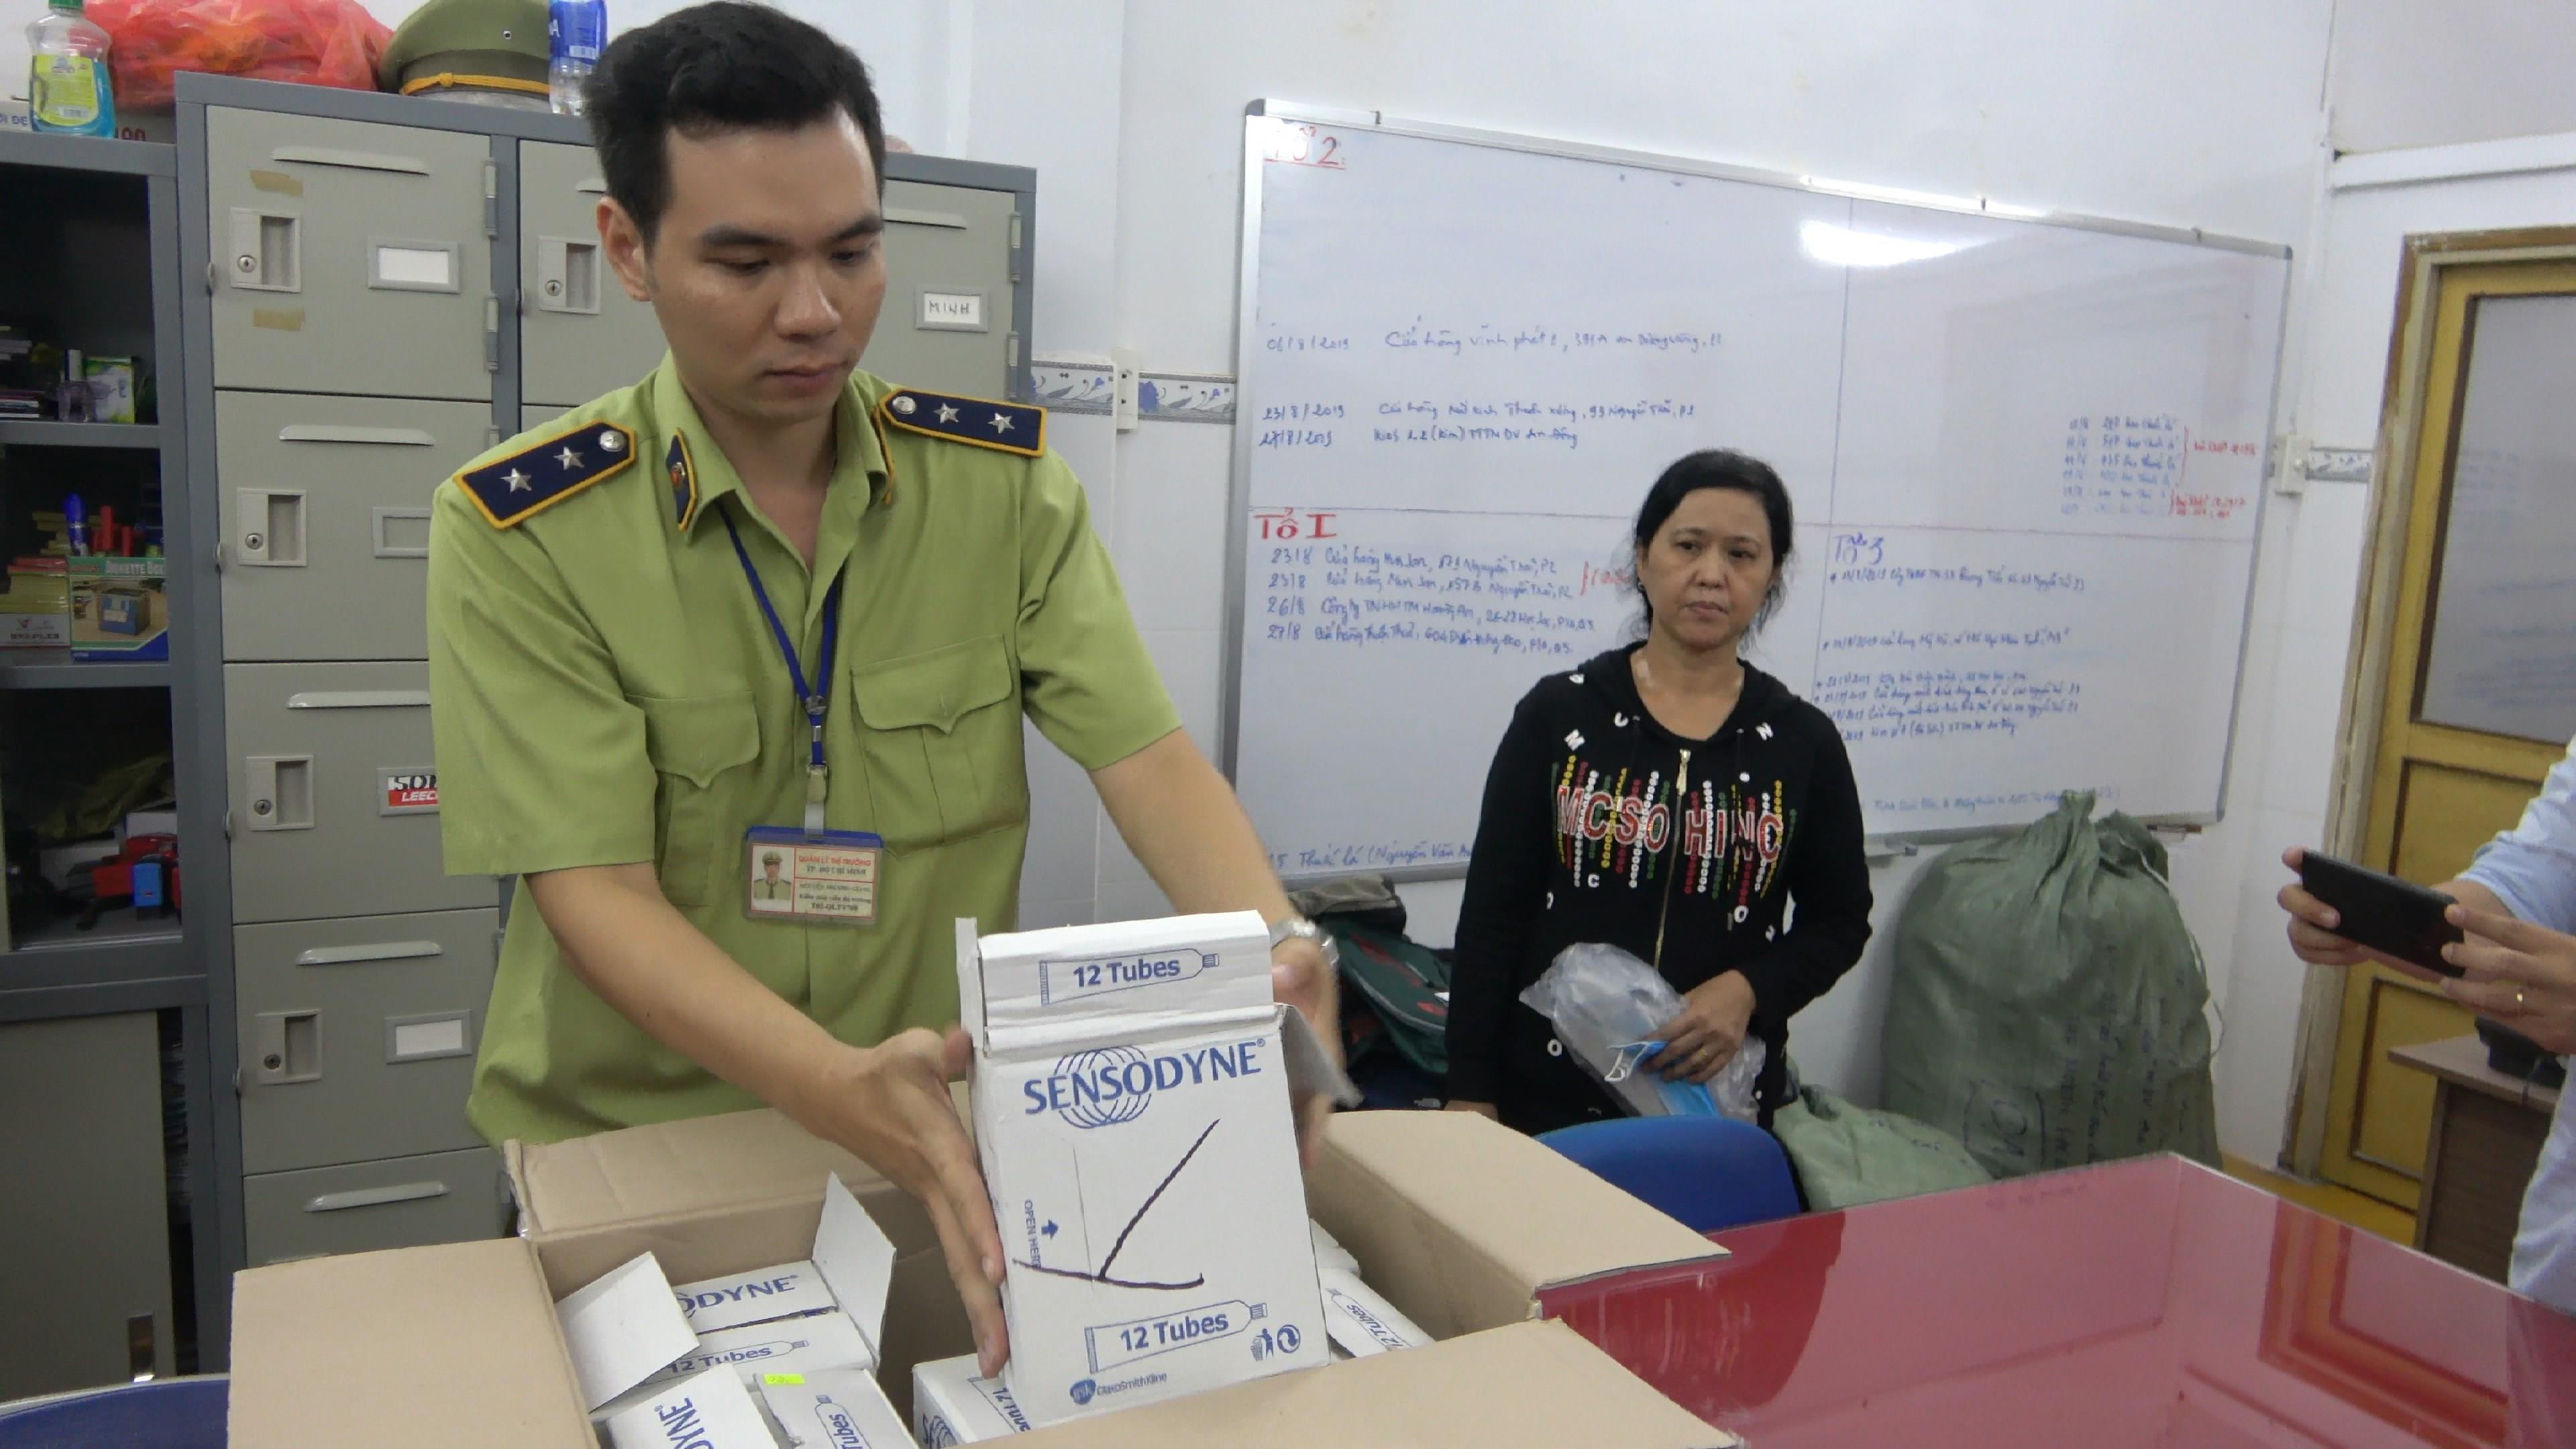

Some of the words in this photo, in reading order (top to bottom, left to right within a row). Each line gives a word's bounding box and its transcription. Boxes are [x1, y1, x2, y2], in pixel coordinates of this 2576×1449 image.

[928, 300, 969, 315] MINH
[1253, 507, 1299, 539] Tổ
[1073, 966, 1101, 987] 12
[1110, 959, 1181, 983] Tubes
[1024, 1041, 1261, 1116] SENSODYNE
[1024, 1199, 1036, 1235] OPEN
[1120, 1328, 1150, 1352] 12
[1152, 1312, 1230, 1345] Tubes
[1346, 1304, 1387, 1337] Tubes
[698, 1347, 773, 1367] Tubes
